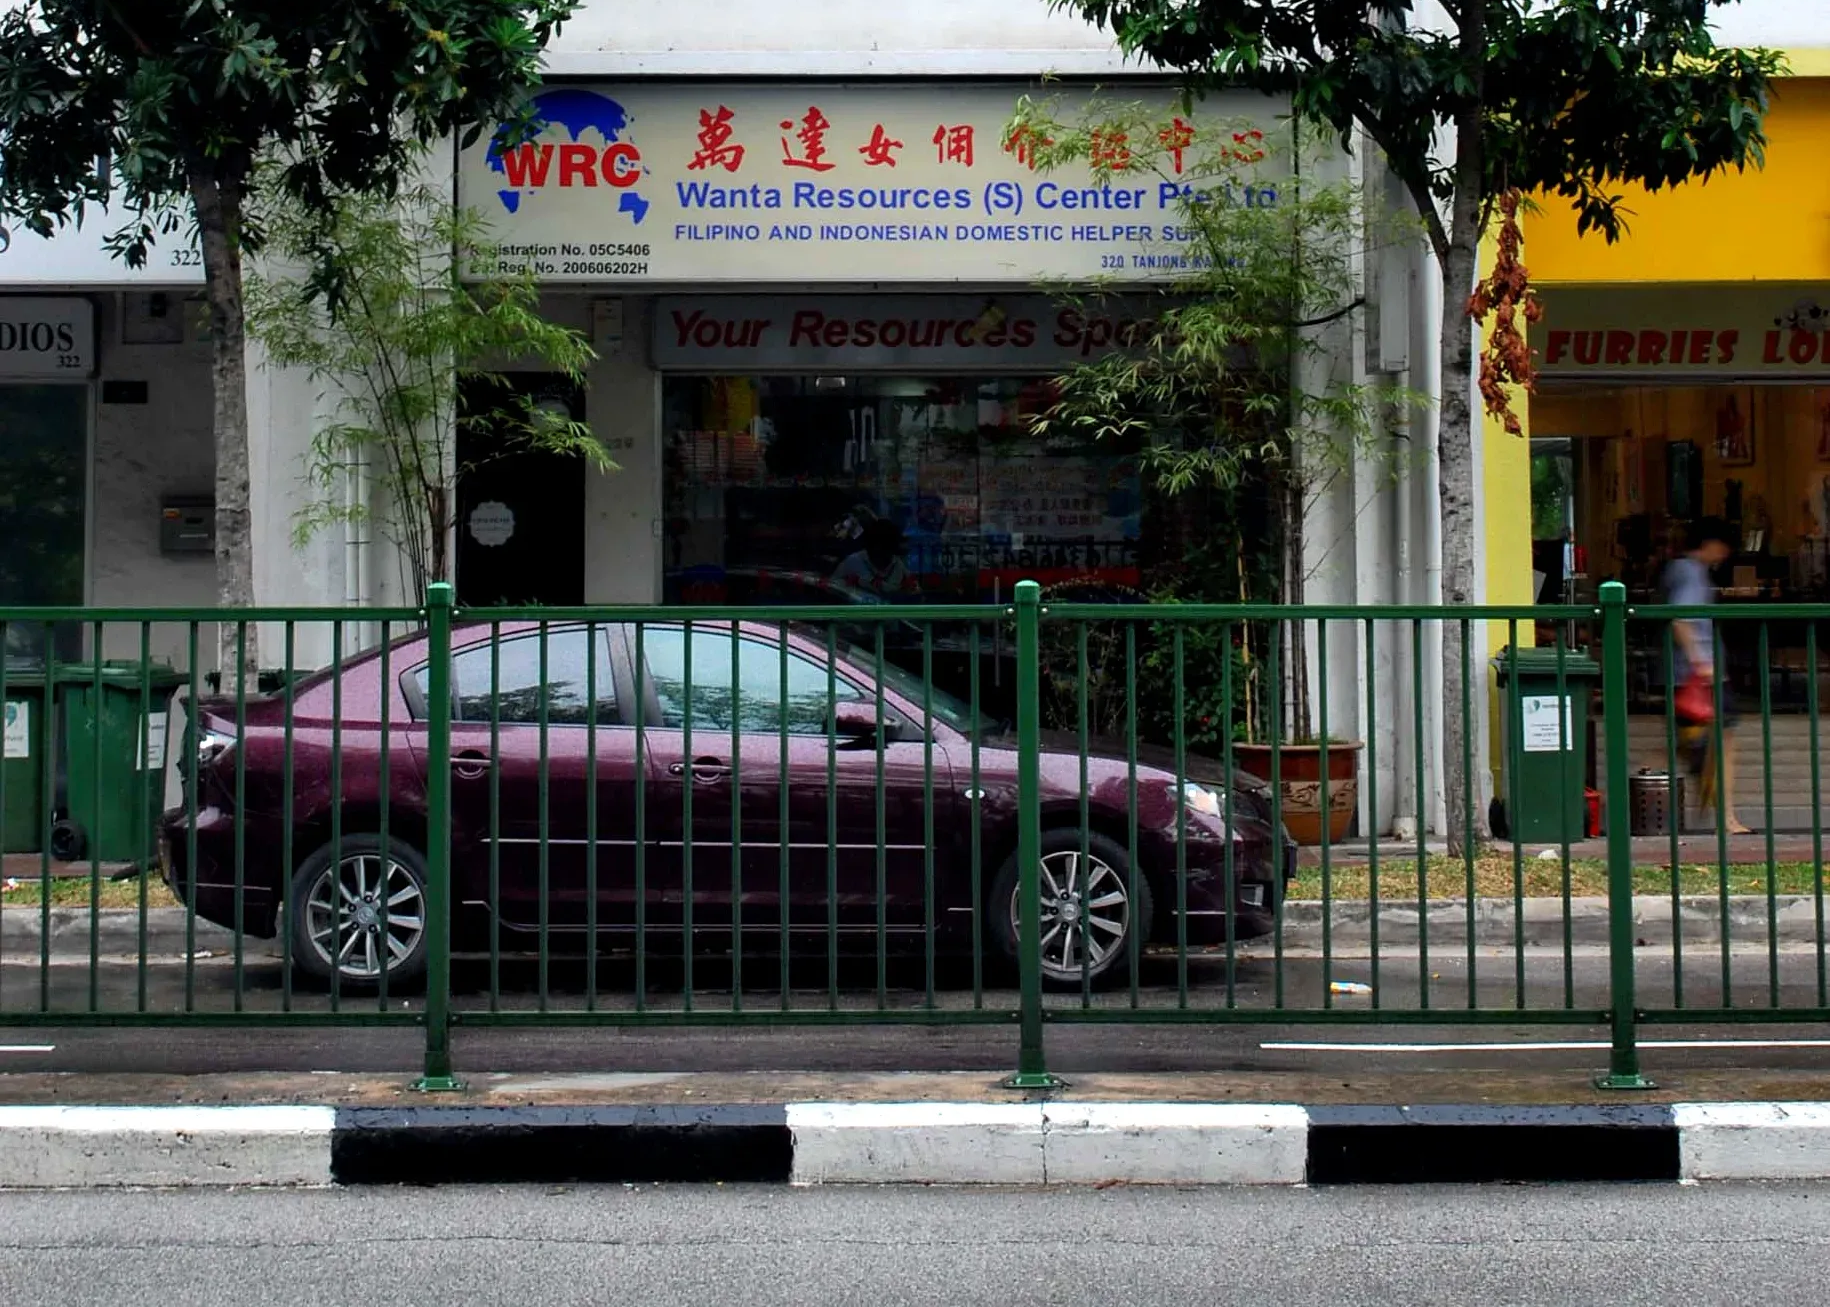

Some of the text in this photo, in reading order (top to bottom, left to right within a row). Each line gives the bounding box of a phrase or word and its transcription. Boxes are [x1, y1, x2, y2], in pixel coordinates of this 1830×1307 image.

[503, 142, 642, 188] WRC
[677, 181, 782, 210] Wanta
[793, 181, 972, 210] Resources
[984, 181, 1024, 216] (S)
[1035, 181, 1147, 210] Center
[1158, 181, 1213, 210] Pte
[675, 225, 760, 241] FILIPINO
[769, 225, 813, 240] AND
[820, 225, 949, 241] INDONESIAN
[956, 225, 1063, 241] DOMESTIC
[1071, 225, 1152, 242] HELPER
[170, 246, 204, 268] 322
[470, 243, 650, 259] Rgistration No. 05C5406
[1101, 253, 1126, 270] 320
[1132, 253, 1189, 270] TANJONG
[535, 262, 559, 275] No.
[563, 262, 648, 275] 200606202H
[0, 322, 74, 352] DIOS
[672, 310, 771, 348] Your
[788, 310, 1038, 348] Resources
[1545, 330, 1739, 366] FURRIES
[56, 355, 81, 368] 322
